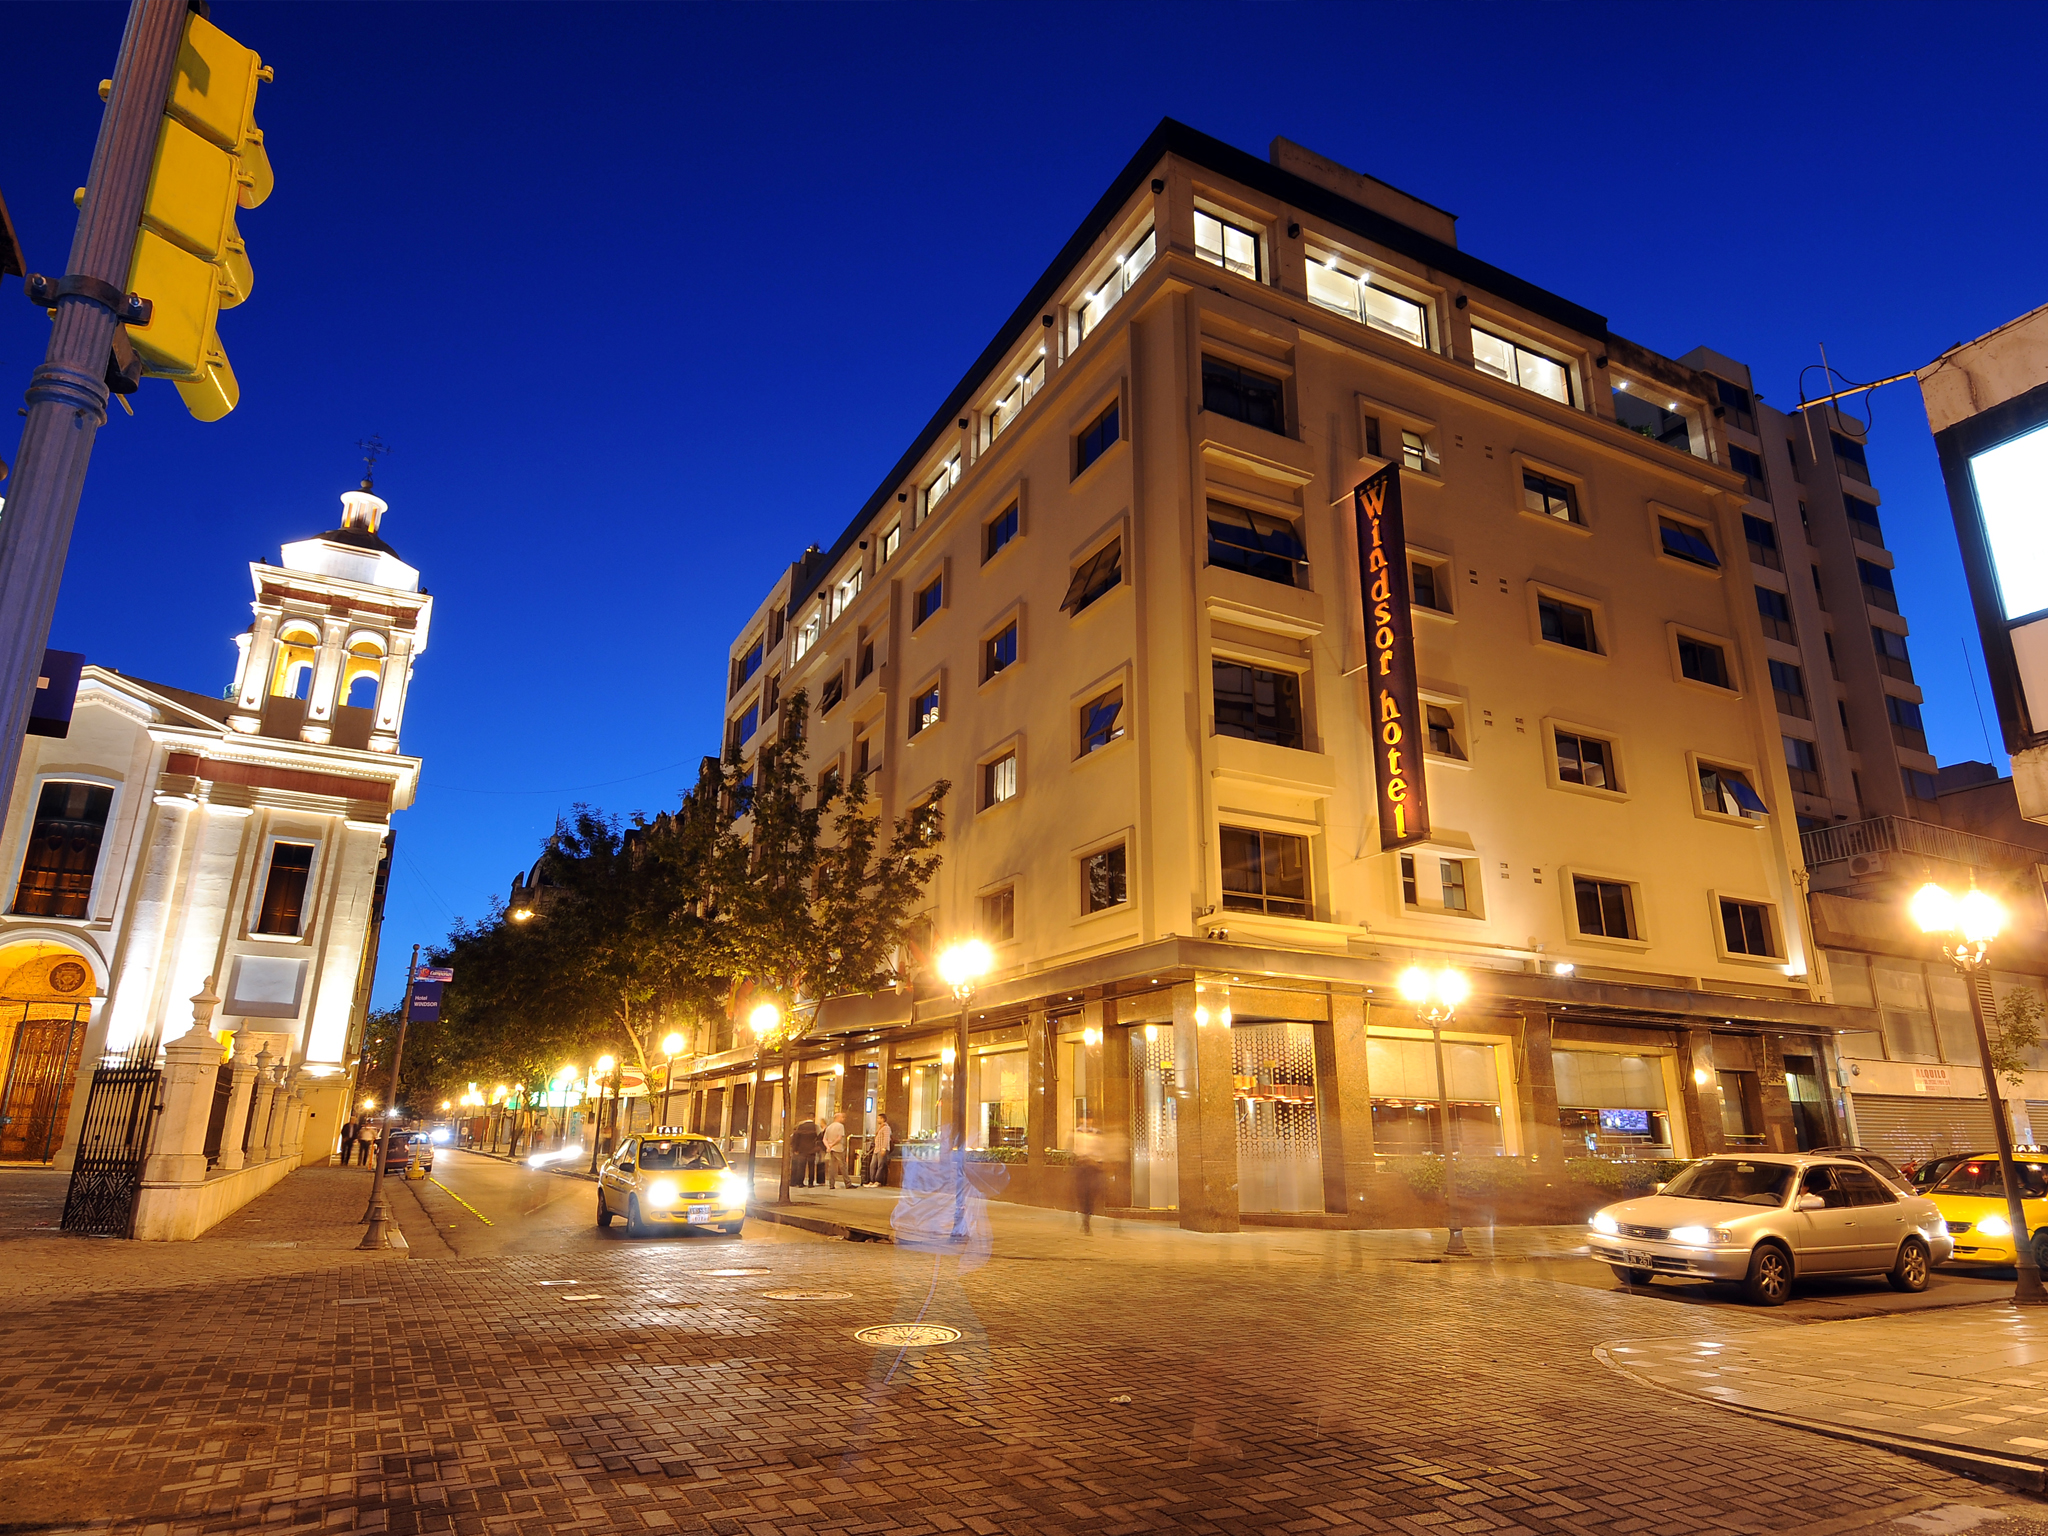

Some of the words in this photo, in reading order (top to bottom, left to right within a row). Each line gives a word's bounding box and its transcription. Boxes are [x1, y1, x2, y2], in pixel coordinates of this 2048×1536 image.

[1359, 480, 1395, 677] Windsor
[1379, 688, 1409, 839] hotel
[1915, 1069, 1946, 1078] ALQUILO
[2012, 1144, 2041, 1153] TAXI
